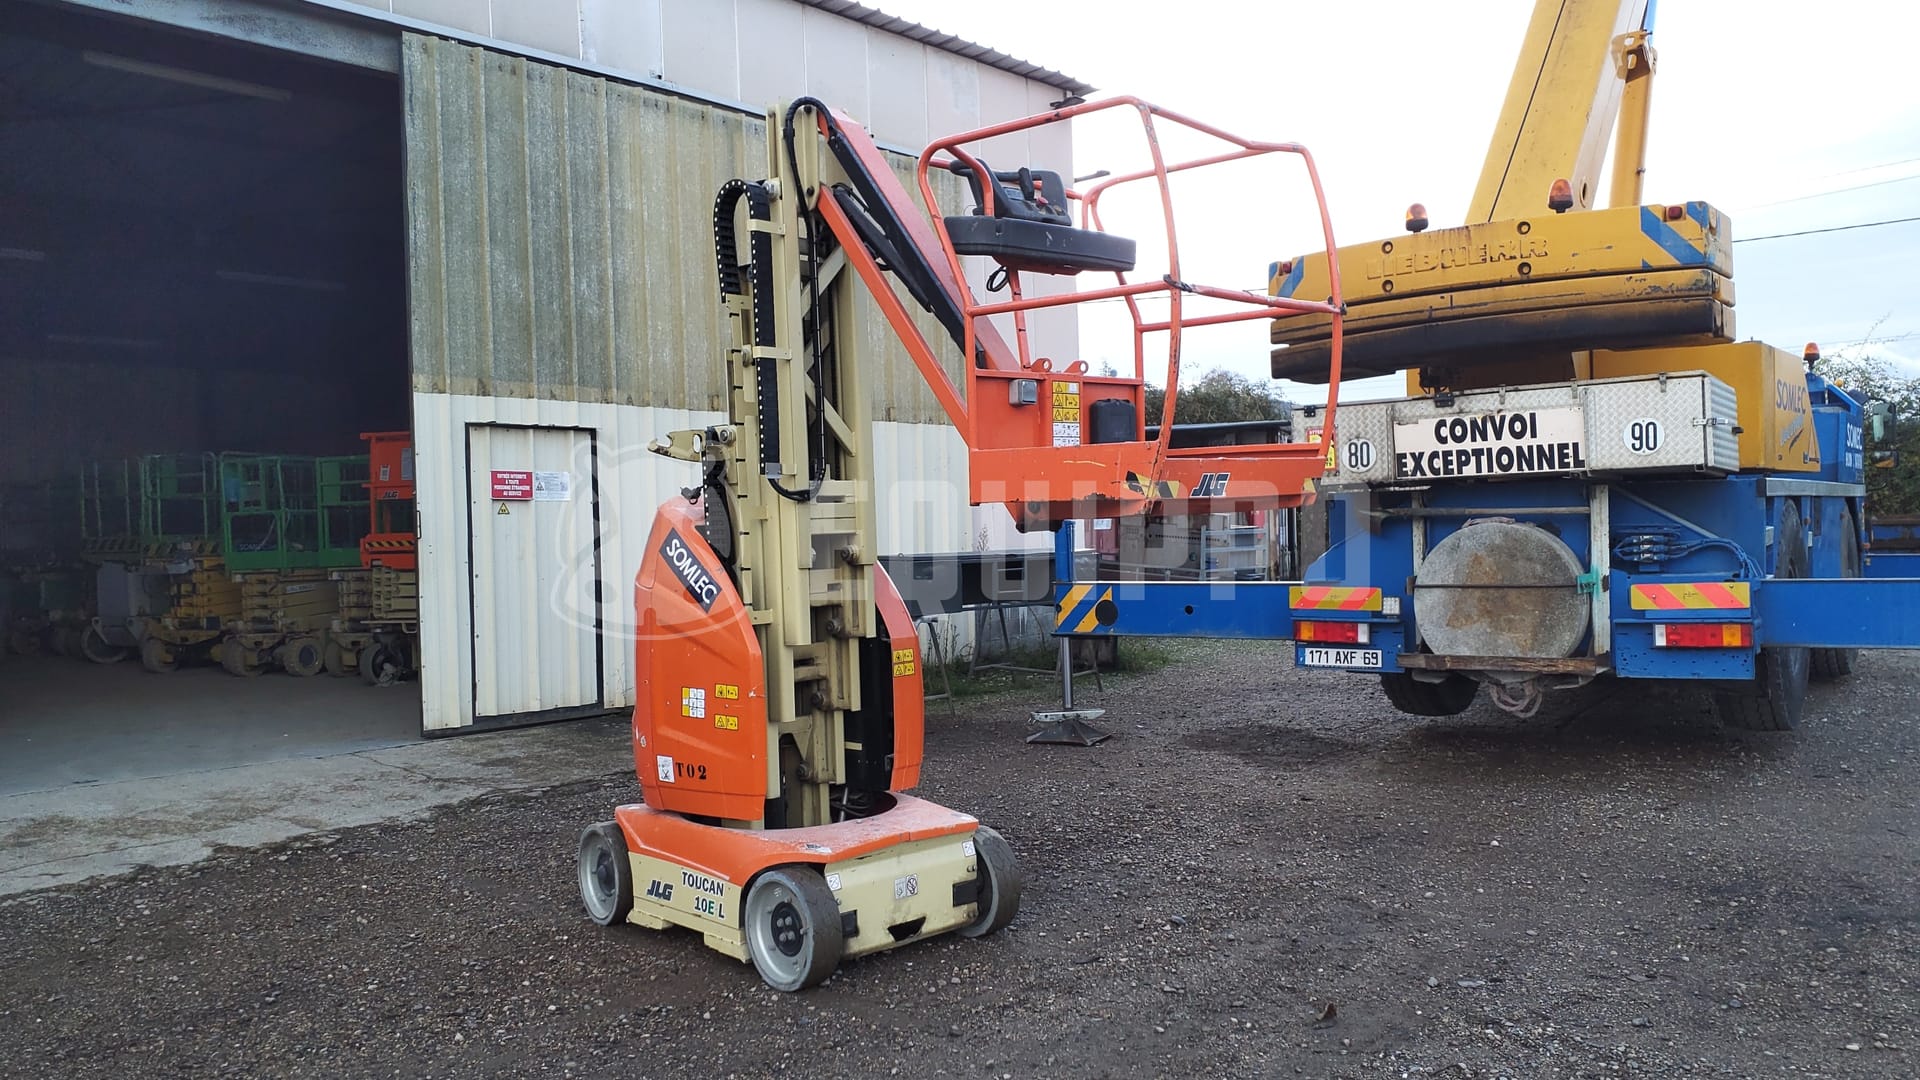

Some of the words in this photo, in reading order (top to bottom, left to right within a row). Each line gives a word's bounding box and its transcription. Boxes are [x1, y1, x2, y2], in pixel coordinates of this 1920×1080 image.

[1776, 379, 1806, 415] SOMLEC
[1434, 412, 1537, 445] CONVOI
[1631, 421, 1657, 451] 90
[1348, 441, 1370, 468] 80
[1396, 442, 1586, 478] EXCEPTIONNEL
[1191, 472, 1231, 497] JLG
[666, 538, 718, 604] SOMLEC
[1309, 650, 1329, 663] 171
[1334, 650, 1357, 665] AXF
[1363, 651, 1379, 666] 69
[646, 879, 674, 901] JLG
[682, 871, 724, 897] TOUCAN
[694, 895, 715, 915] 10E
[718, 903, 725, 919] L
